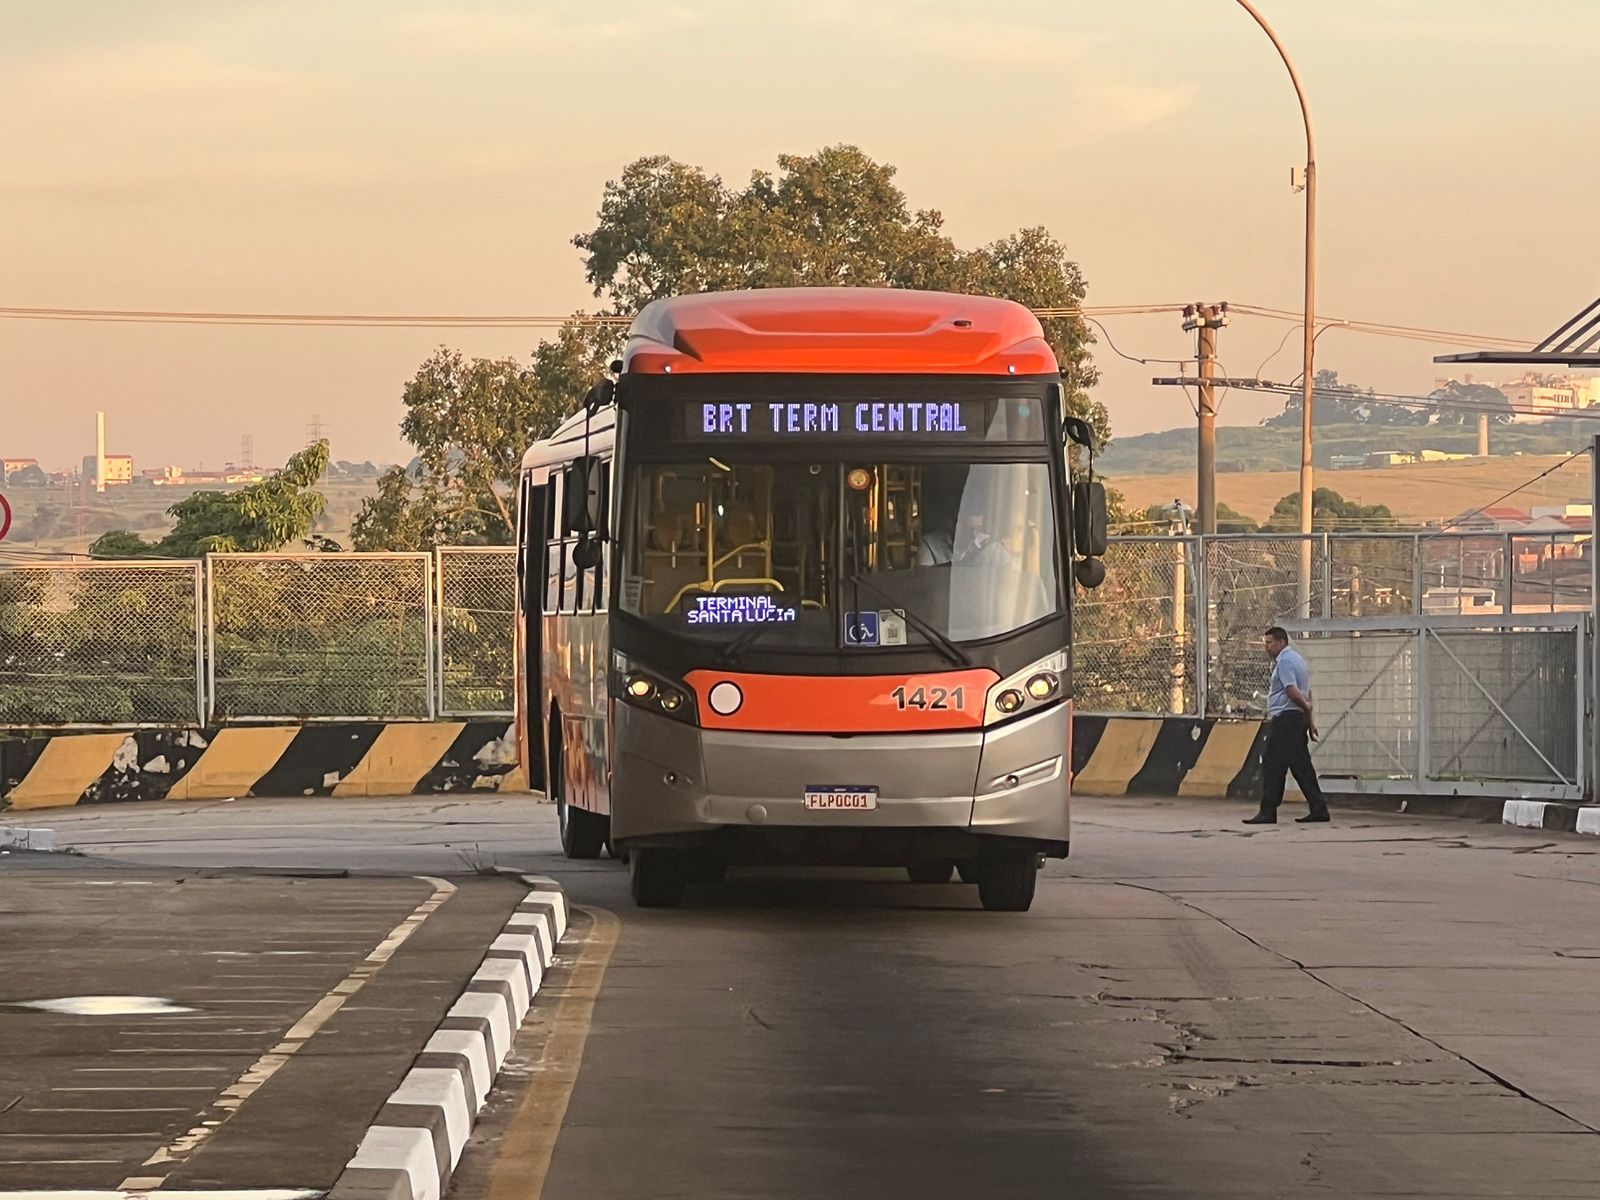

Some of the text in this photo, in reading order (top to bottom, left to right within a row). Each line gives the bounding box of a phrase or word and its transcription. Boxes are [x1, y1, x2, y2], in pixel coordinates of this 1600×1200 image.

[703, 403, 967, 433] BRT TERM CENTRAL
[696, 596, 777, 611] TERMINAL
[687, 608, 796, 624] SANTA LUCIA
[891, 685, 965, 710] 1421
